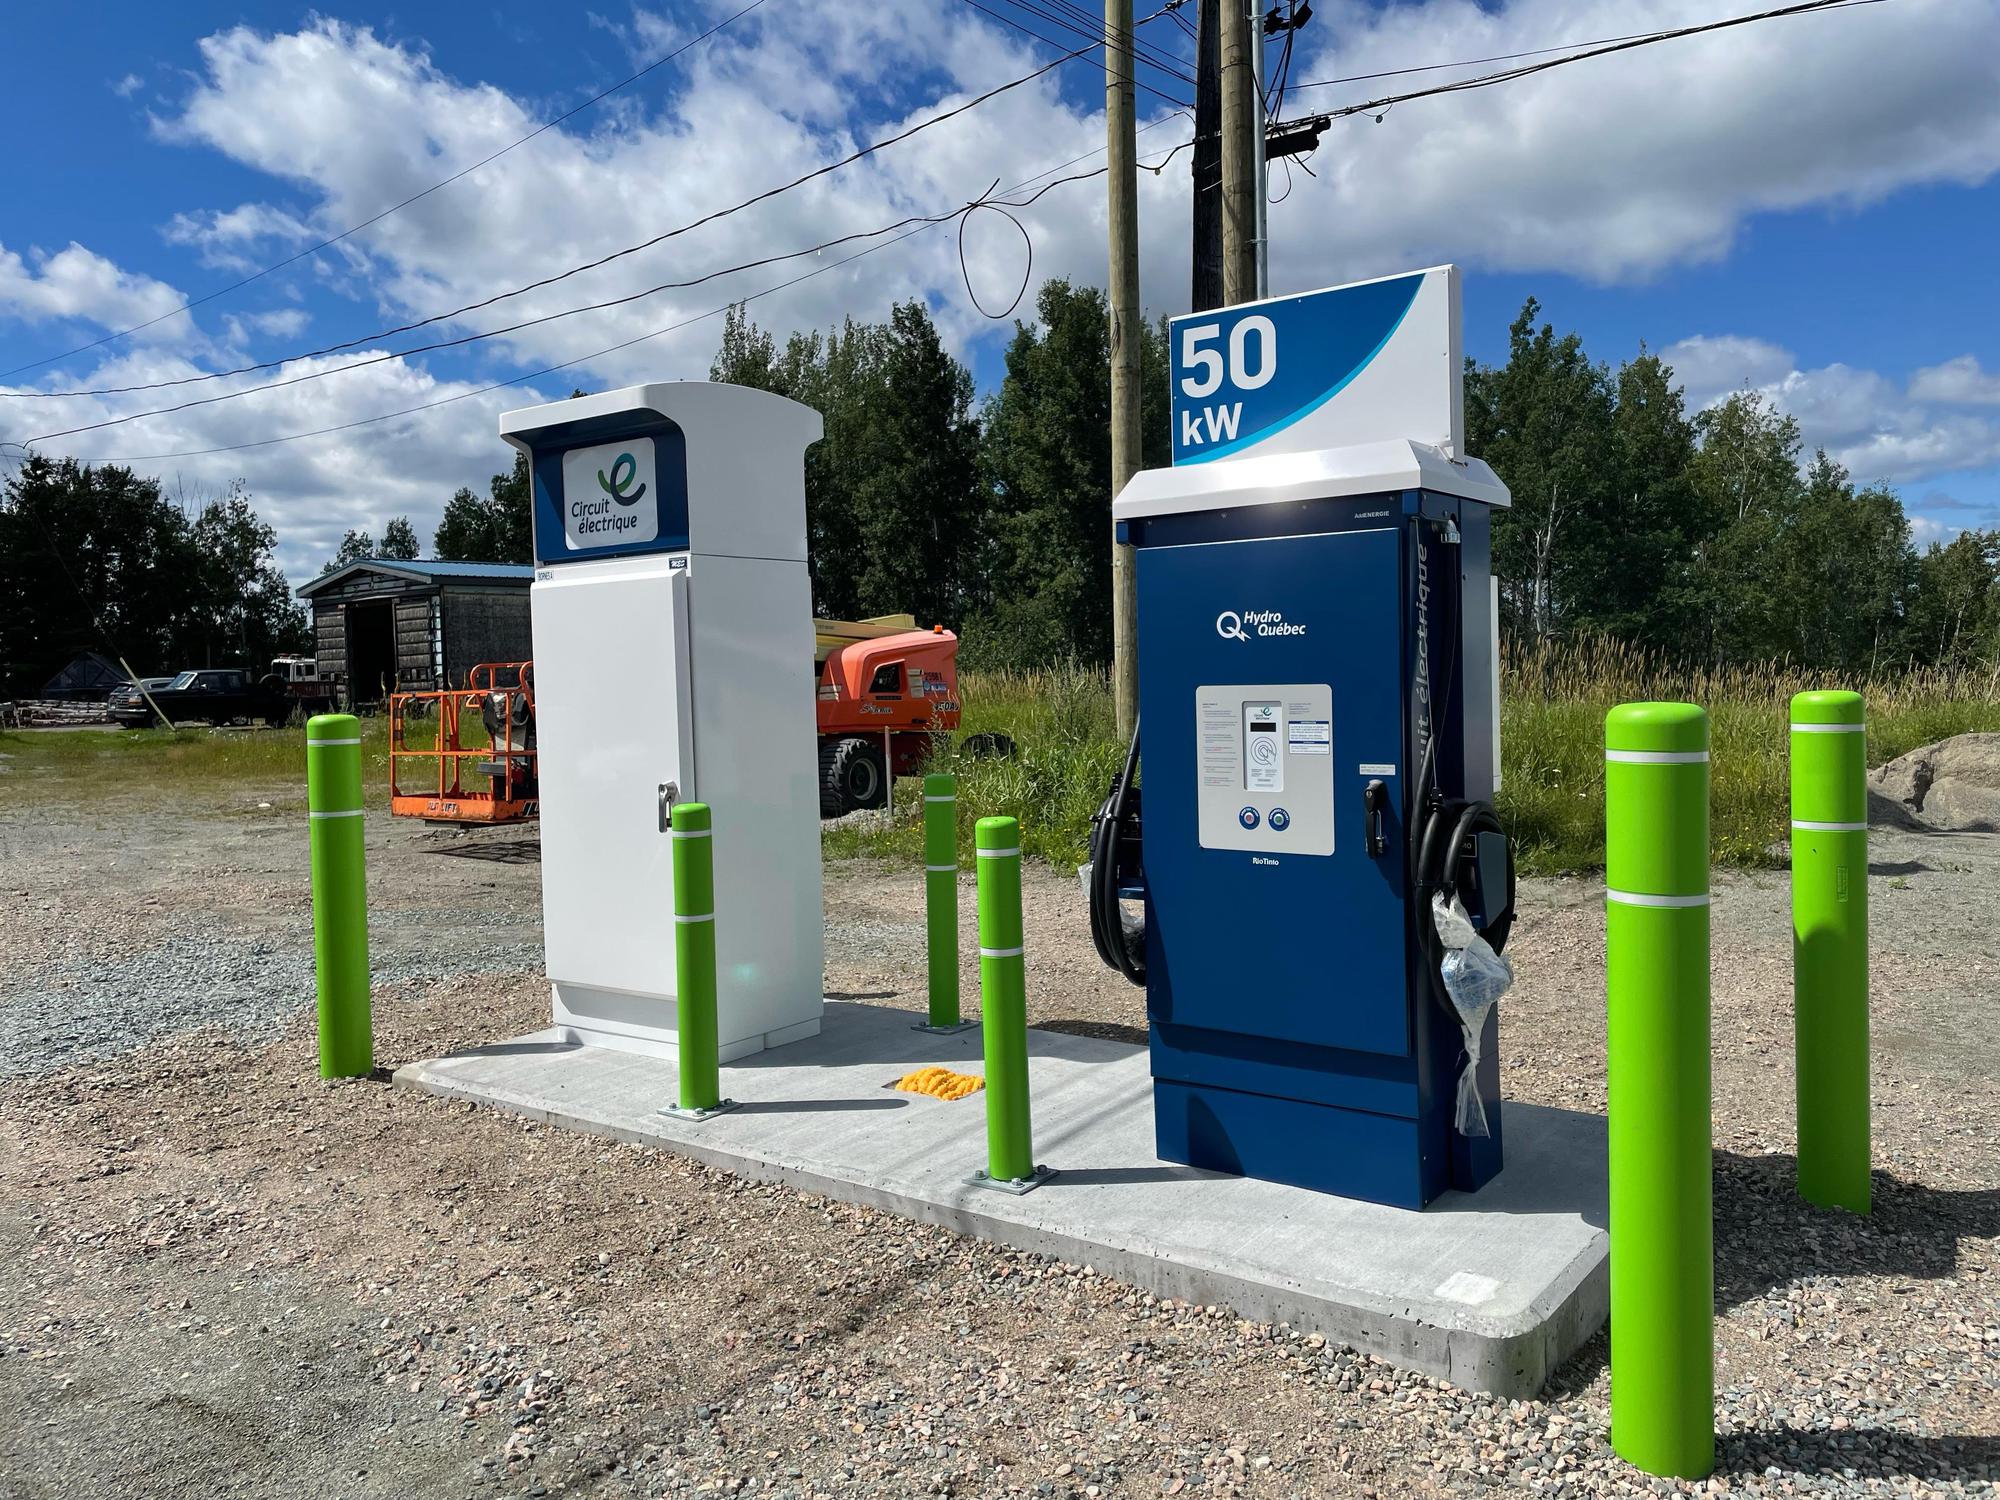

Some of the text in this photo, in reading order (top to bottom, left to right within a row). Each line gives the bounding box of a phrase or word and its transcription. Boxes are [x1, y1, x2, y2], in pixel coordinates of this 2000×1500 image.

[1181, 315, 1277, 398] 50
[1182, 402, 1243, 446] kW
[571, 498, 610, 517] Circuit
[578, 515, 638, 534] électrique
[1244, 610, 1282, 626] Hydro
[1416, 543, 1431, 704] électrique
[1257, 622, 1306, 637] Québec
